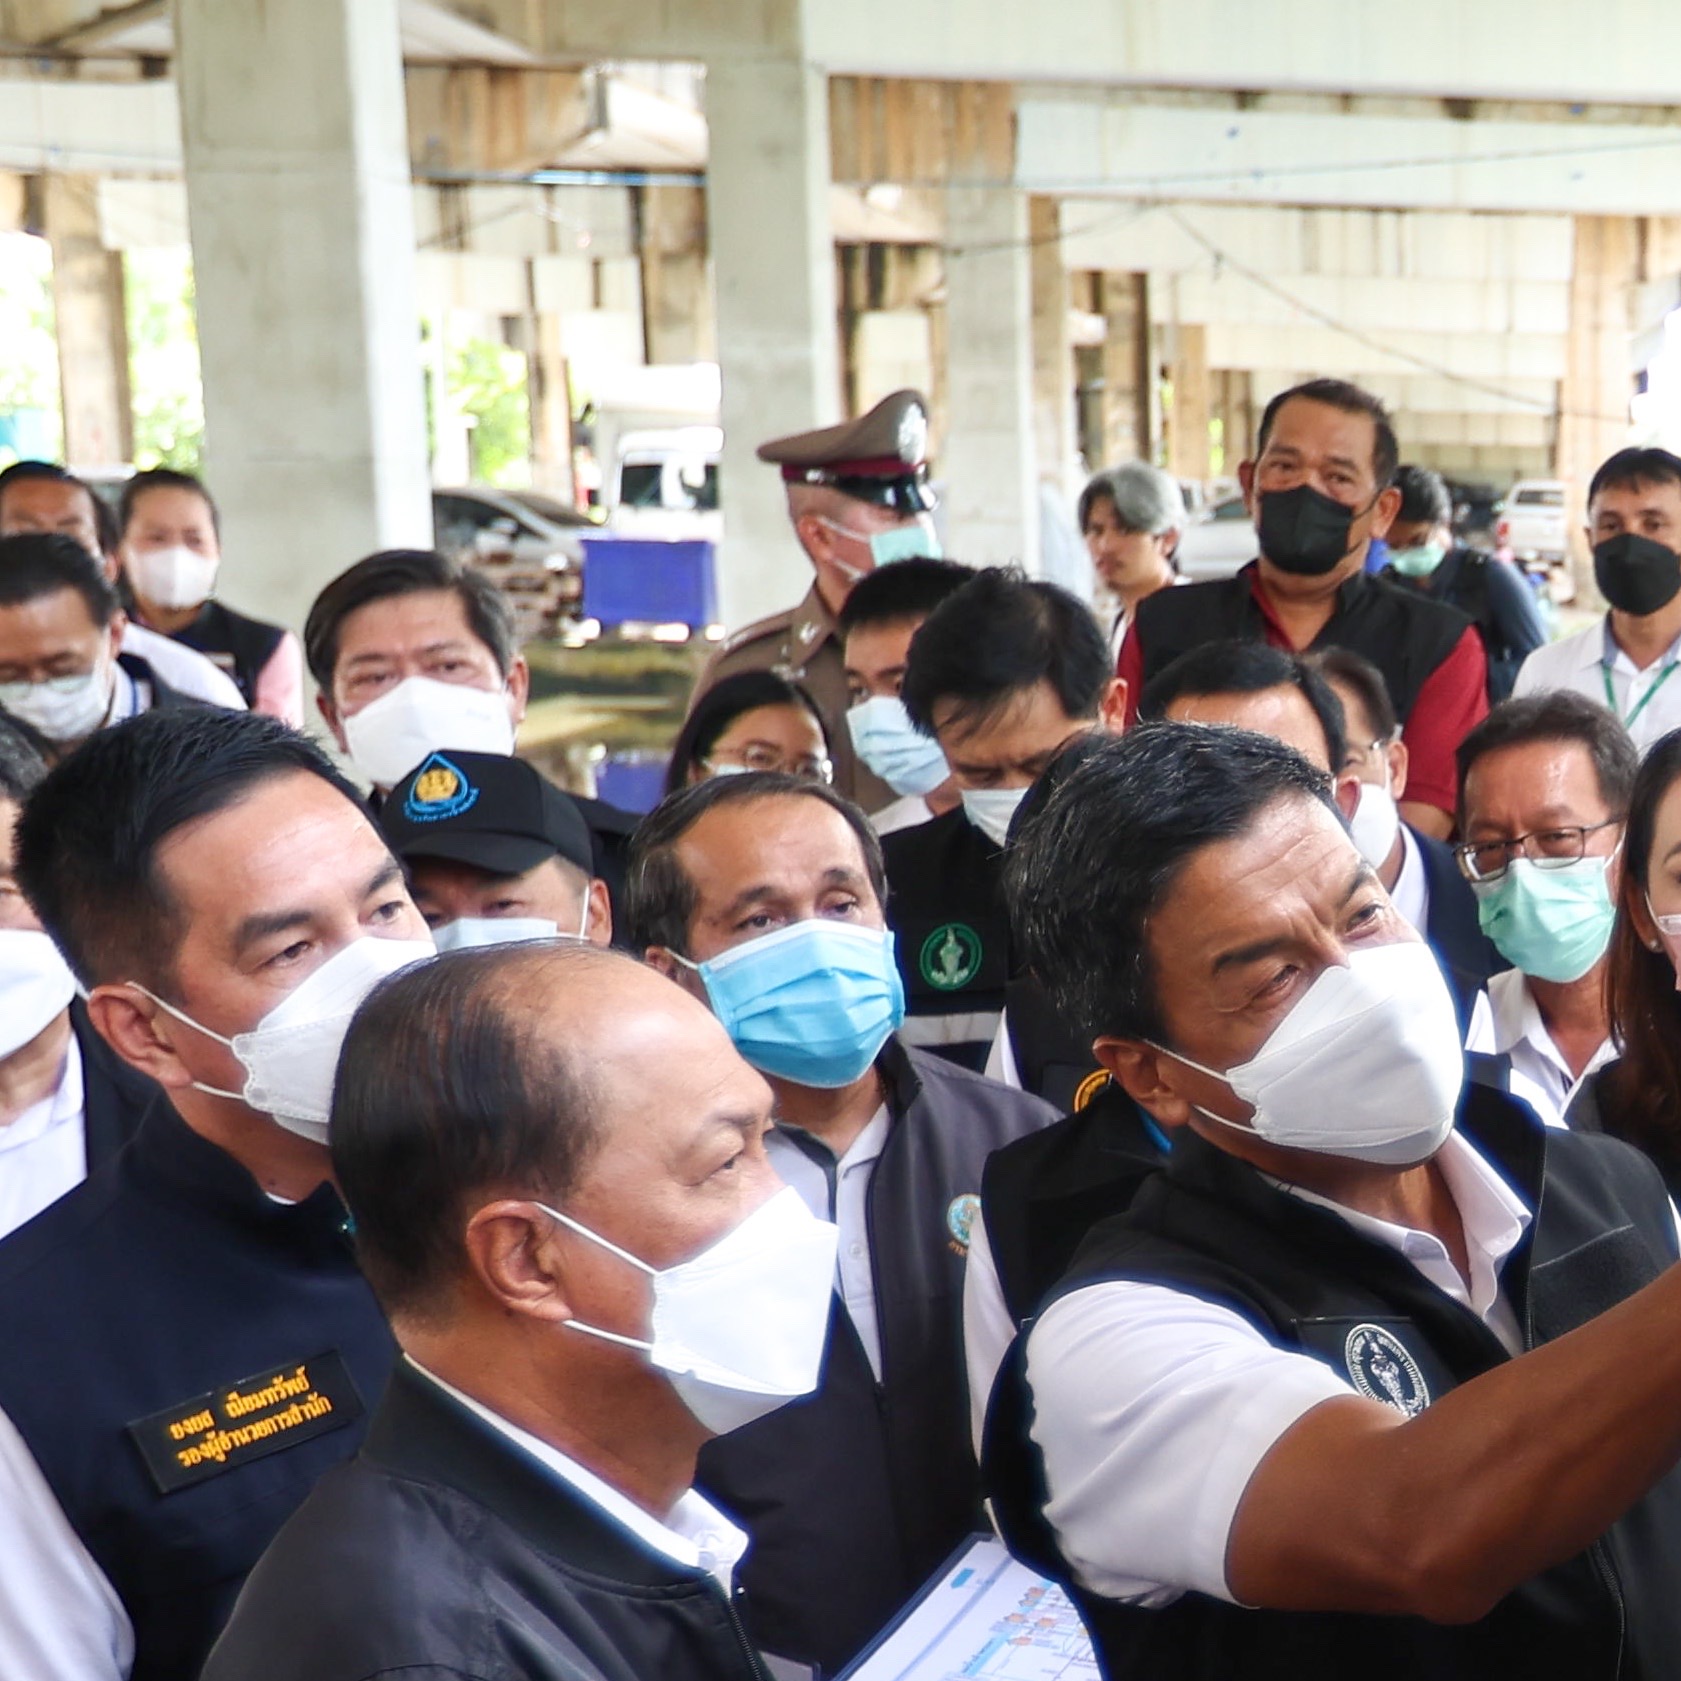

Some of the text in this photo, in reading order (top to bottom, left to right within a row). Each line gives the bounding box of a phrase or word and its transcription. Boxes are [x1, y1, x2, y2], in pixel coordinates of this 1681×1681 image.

[177, 1392, 332, 1466] รองผู้อำนวยการสำนัก
